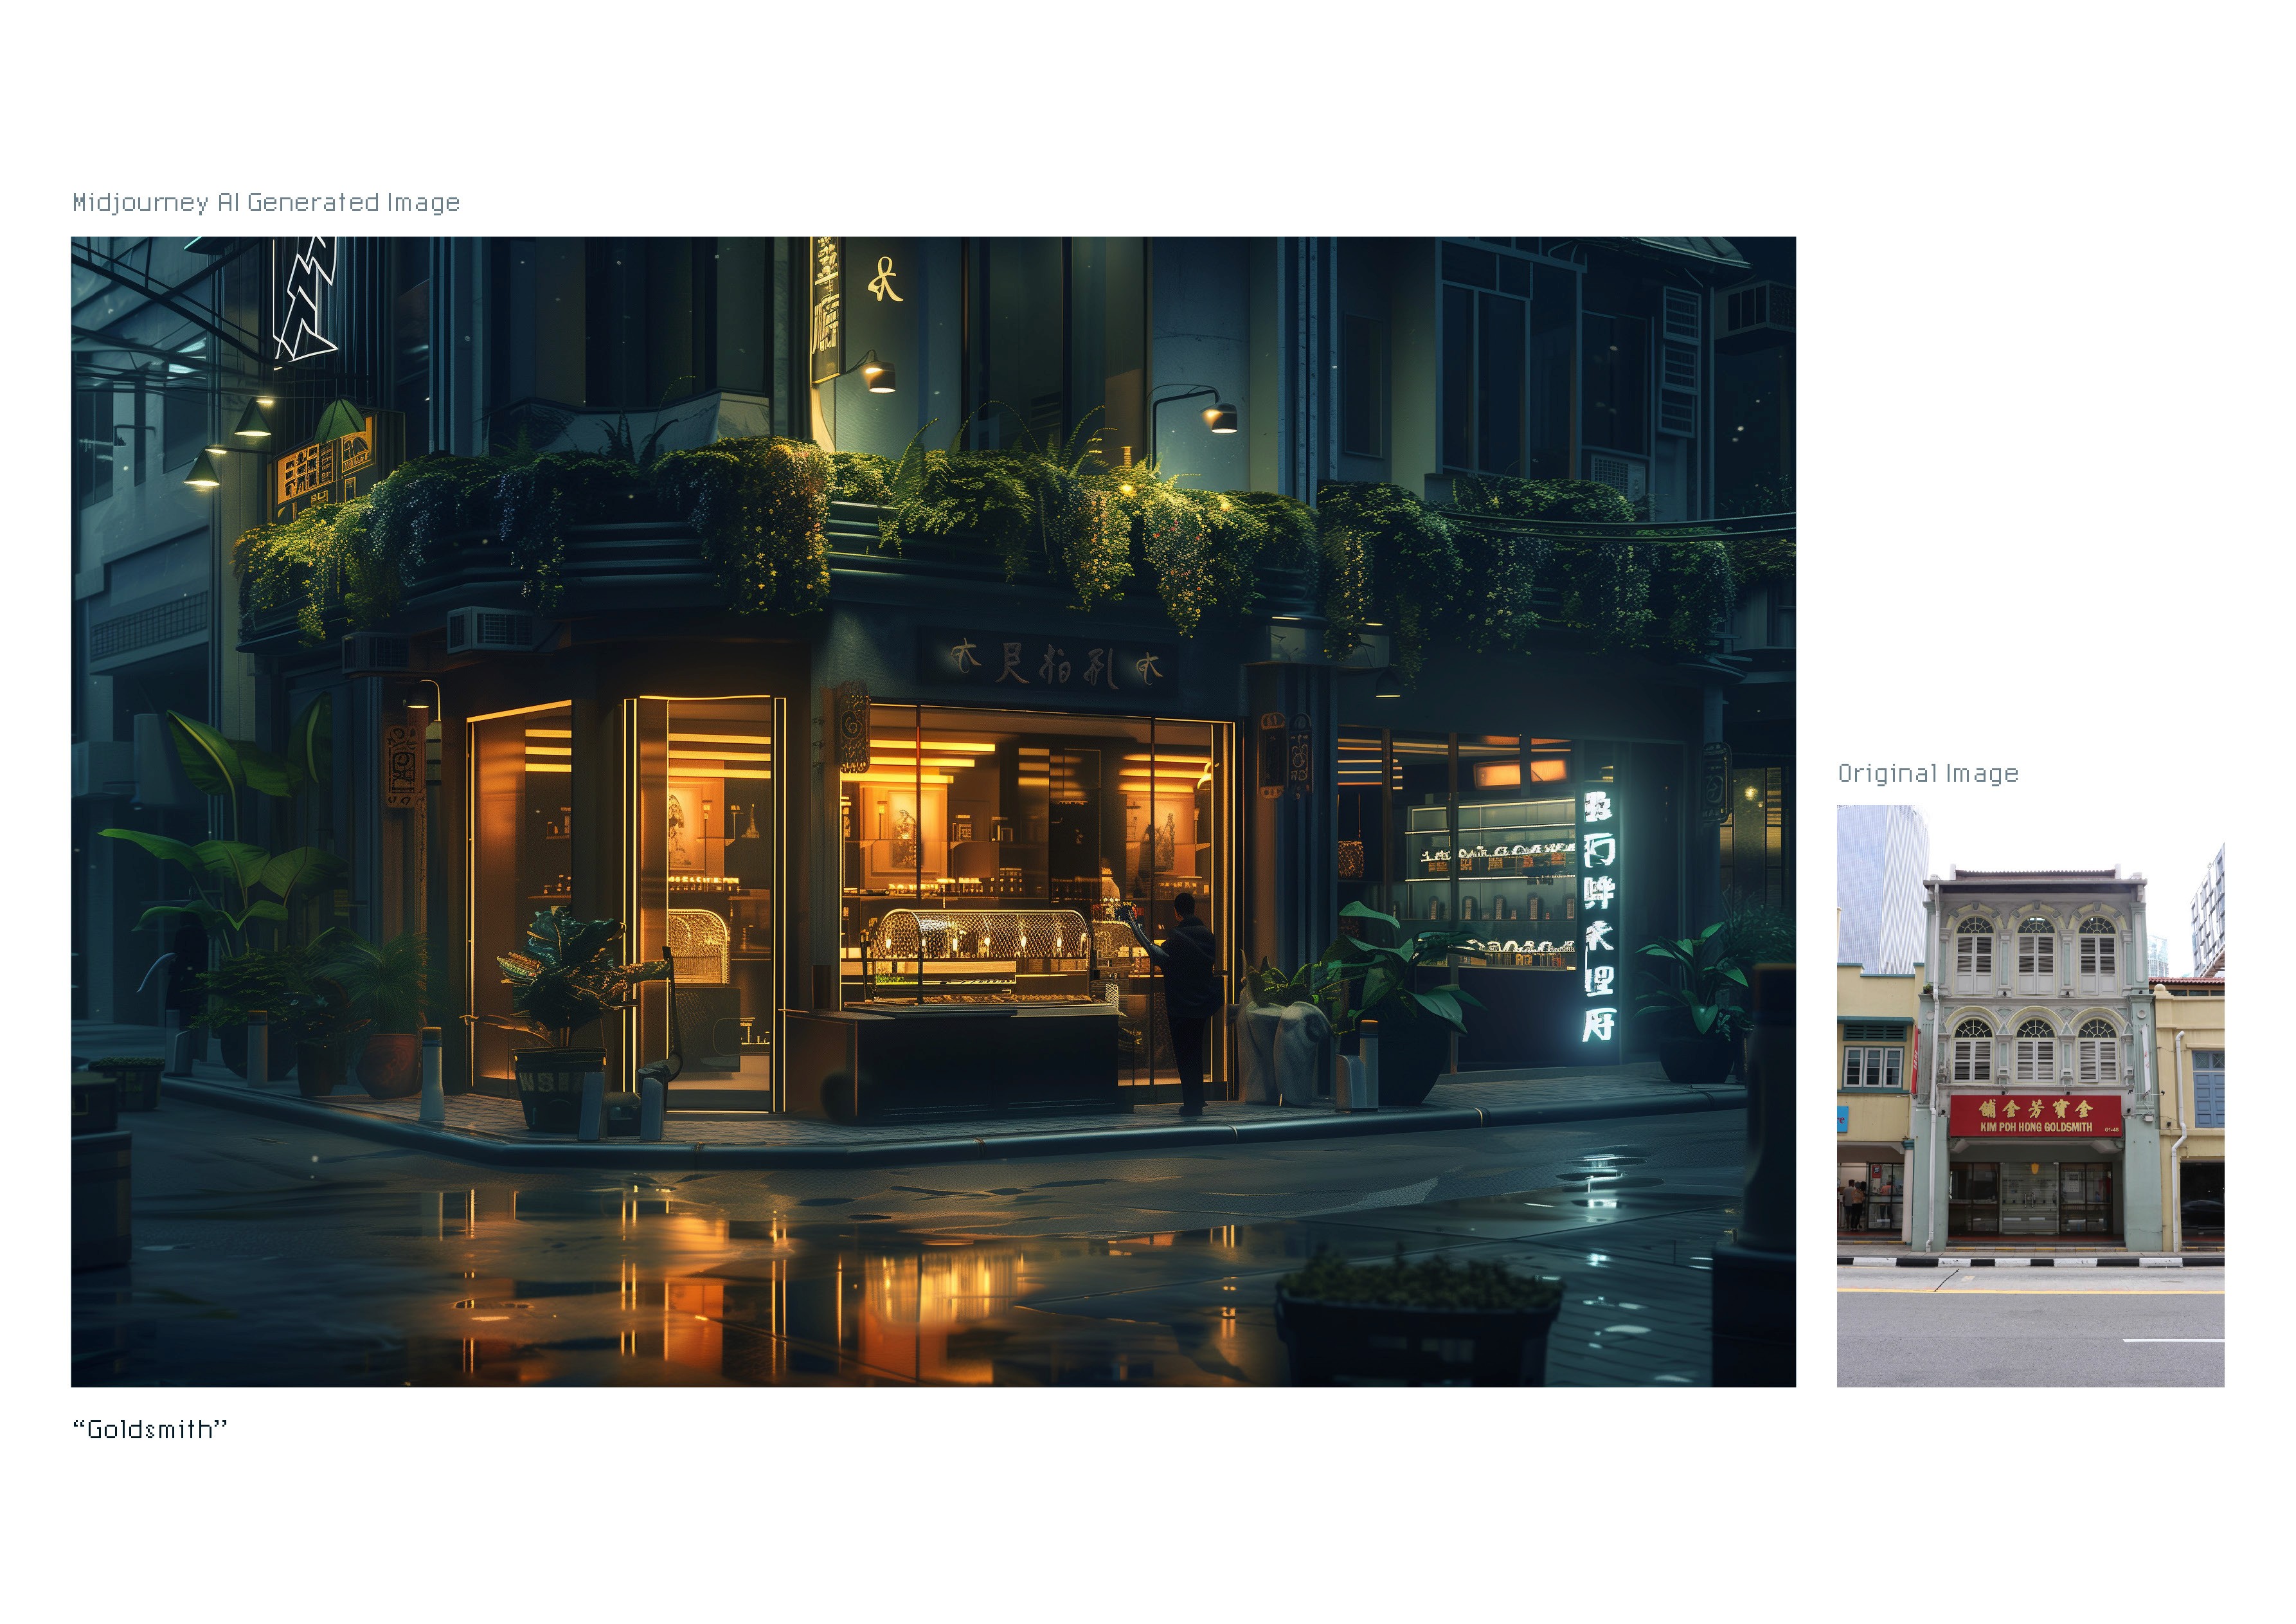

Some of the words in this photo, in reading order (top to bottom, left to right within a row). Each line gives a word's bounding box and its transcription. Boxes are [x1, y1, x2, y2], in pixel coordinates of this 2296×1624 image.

[1980, 1122, 1997, 1132] KIM
[1999, 1122, 2016, 1132] POH
[2018, 1122, 2042, 1132] HONG
[2044, 1122, 2092, 1132] GOLDSMITH
